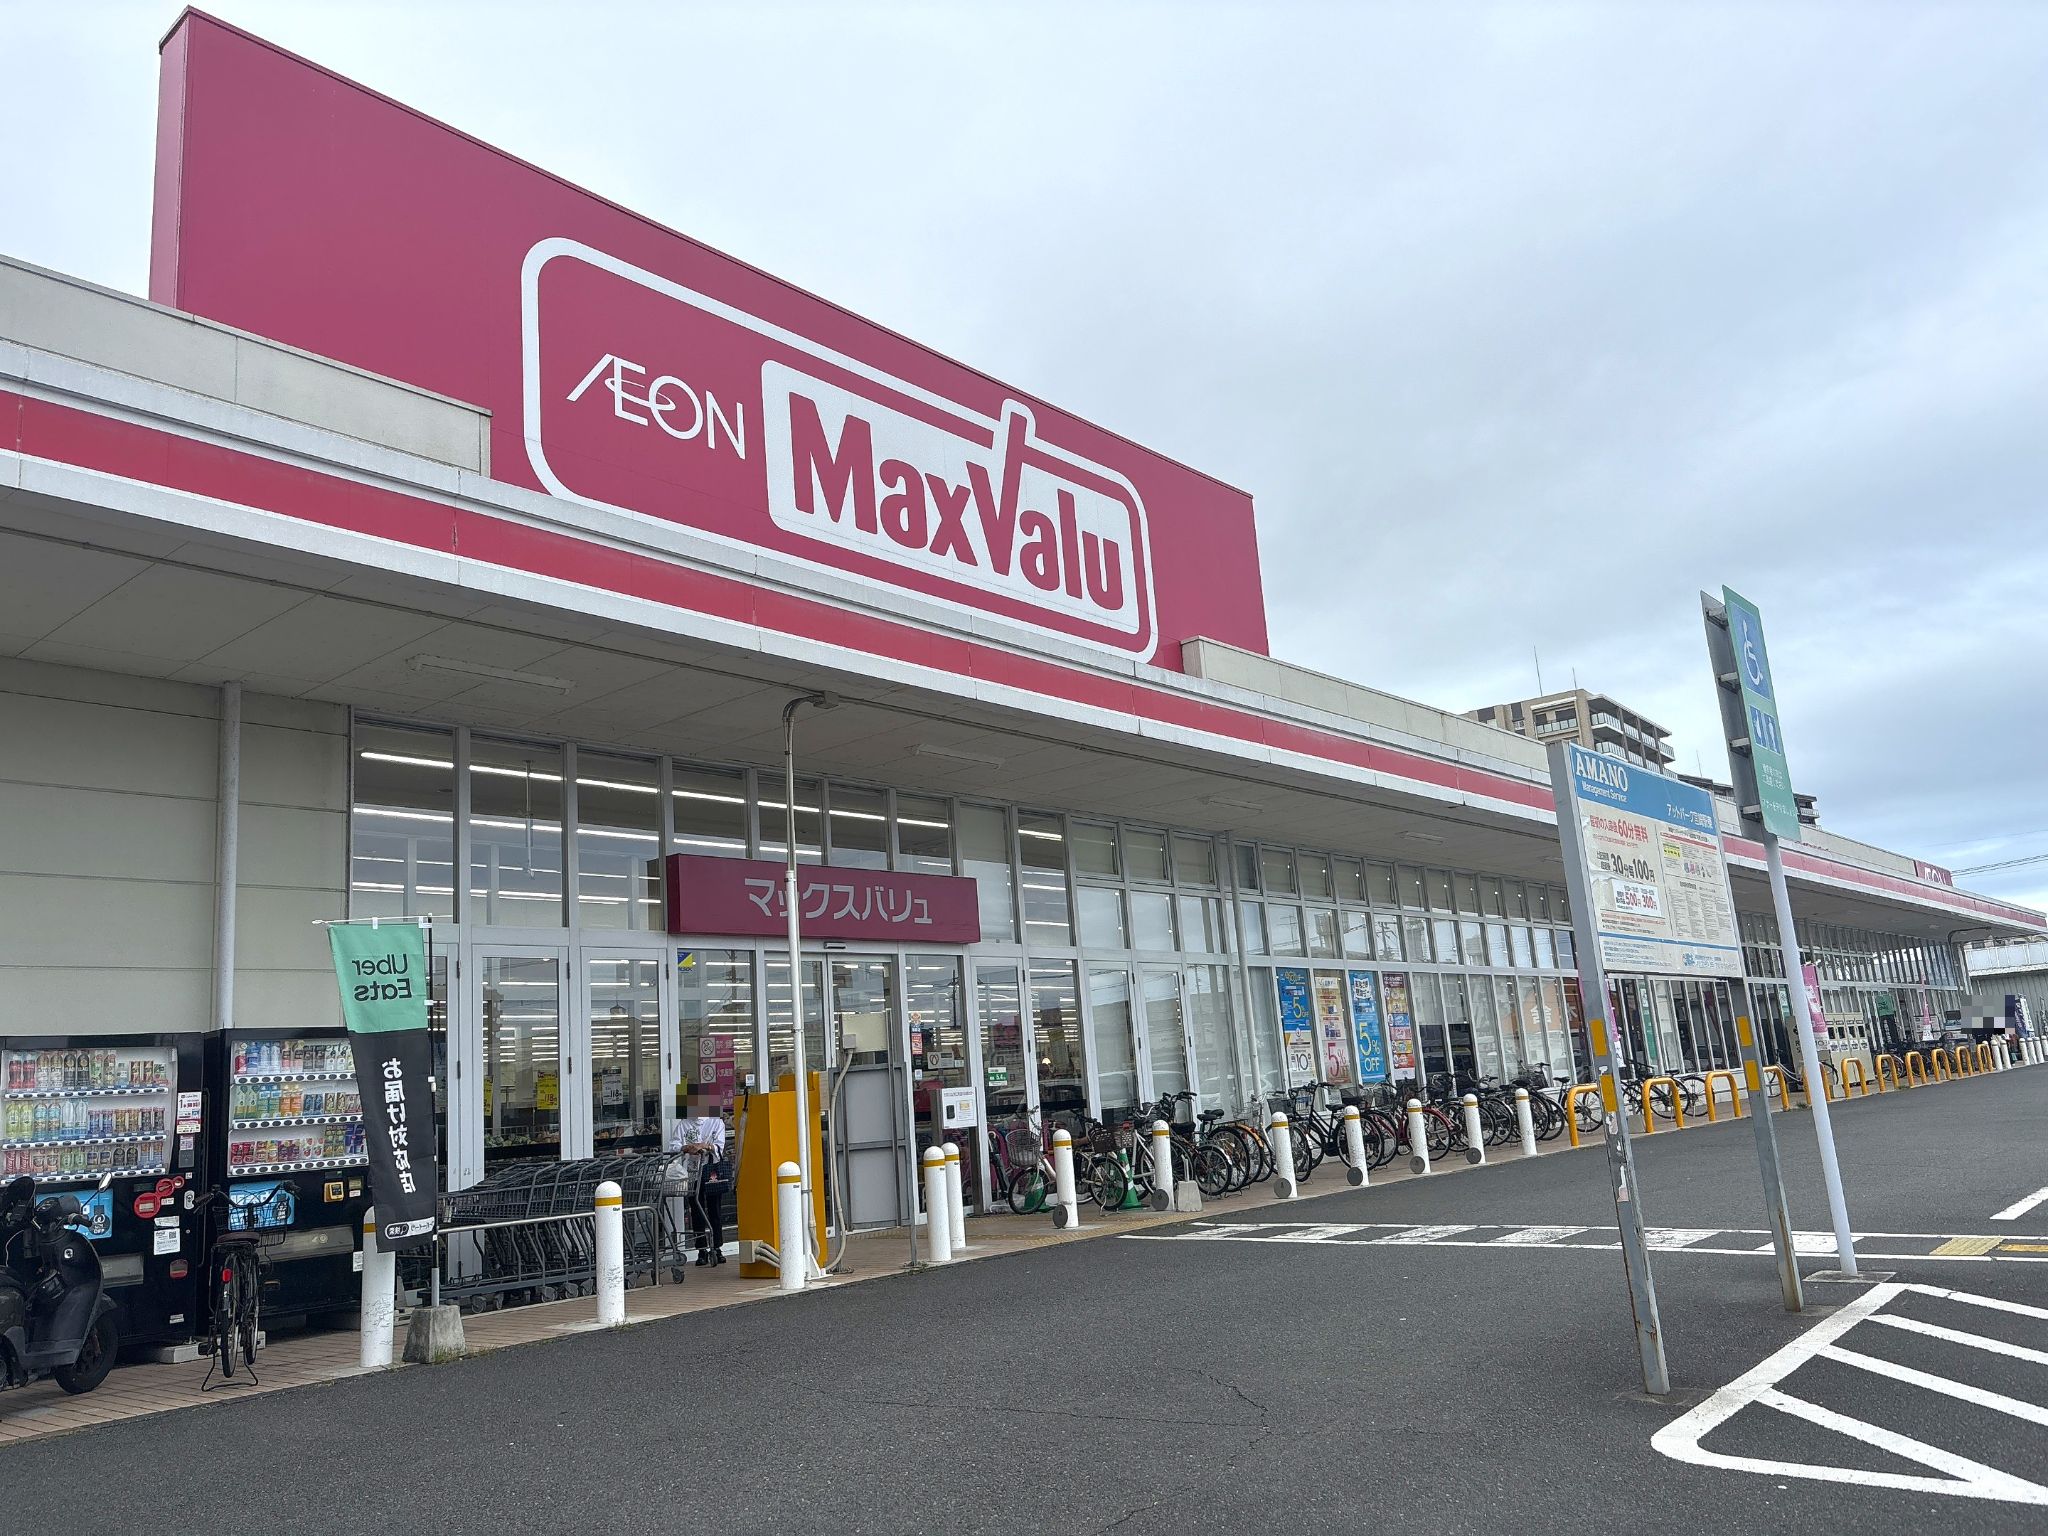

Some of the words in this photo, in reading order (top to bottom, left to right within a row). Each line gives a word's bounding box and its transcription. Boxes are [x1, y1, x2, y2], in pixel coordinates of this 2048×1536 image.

[789, 391, 1123, 611] MaxValu
[1575, 752, 1629, 792] AMANO
[1581, 780, 1611, 798] Management
[1610, 788, 1628, 803] Service
[1364, 1058, 1380, 1072] OFF
